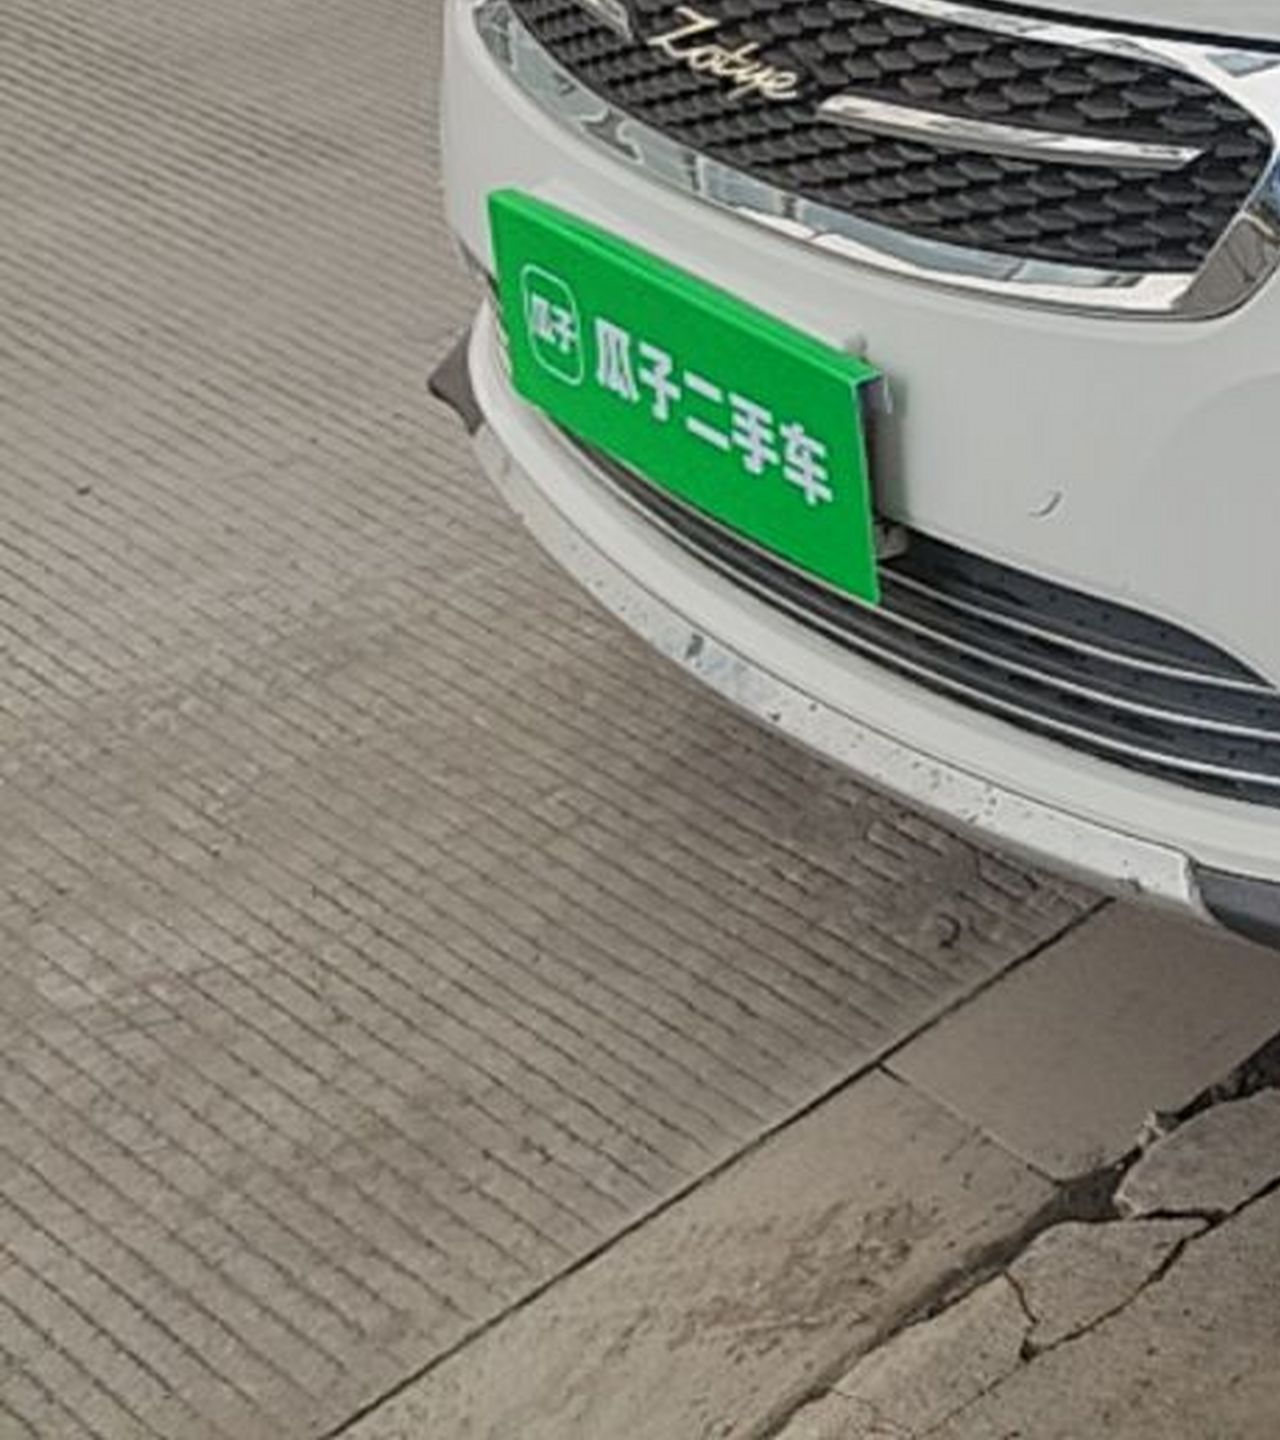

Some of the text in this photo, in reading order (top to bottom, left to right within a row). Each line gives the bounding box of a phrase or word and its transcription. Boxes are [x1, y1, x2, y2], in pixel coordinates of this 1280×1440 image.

[595, 316, 834, 507] 瓜子二手车
